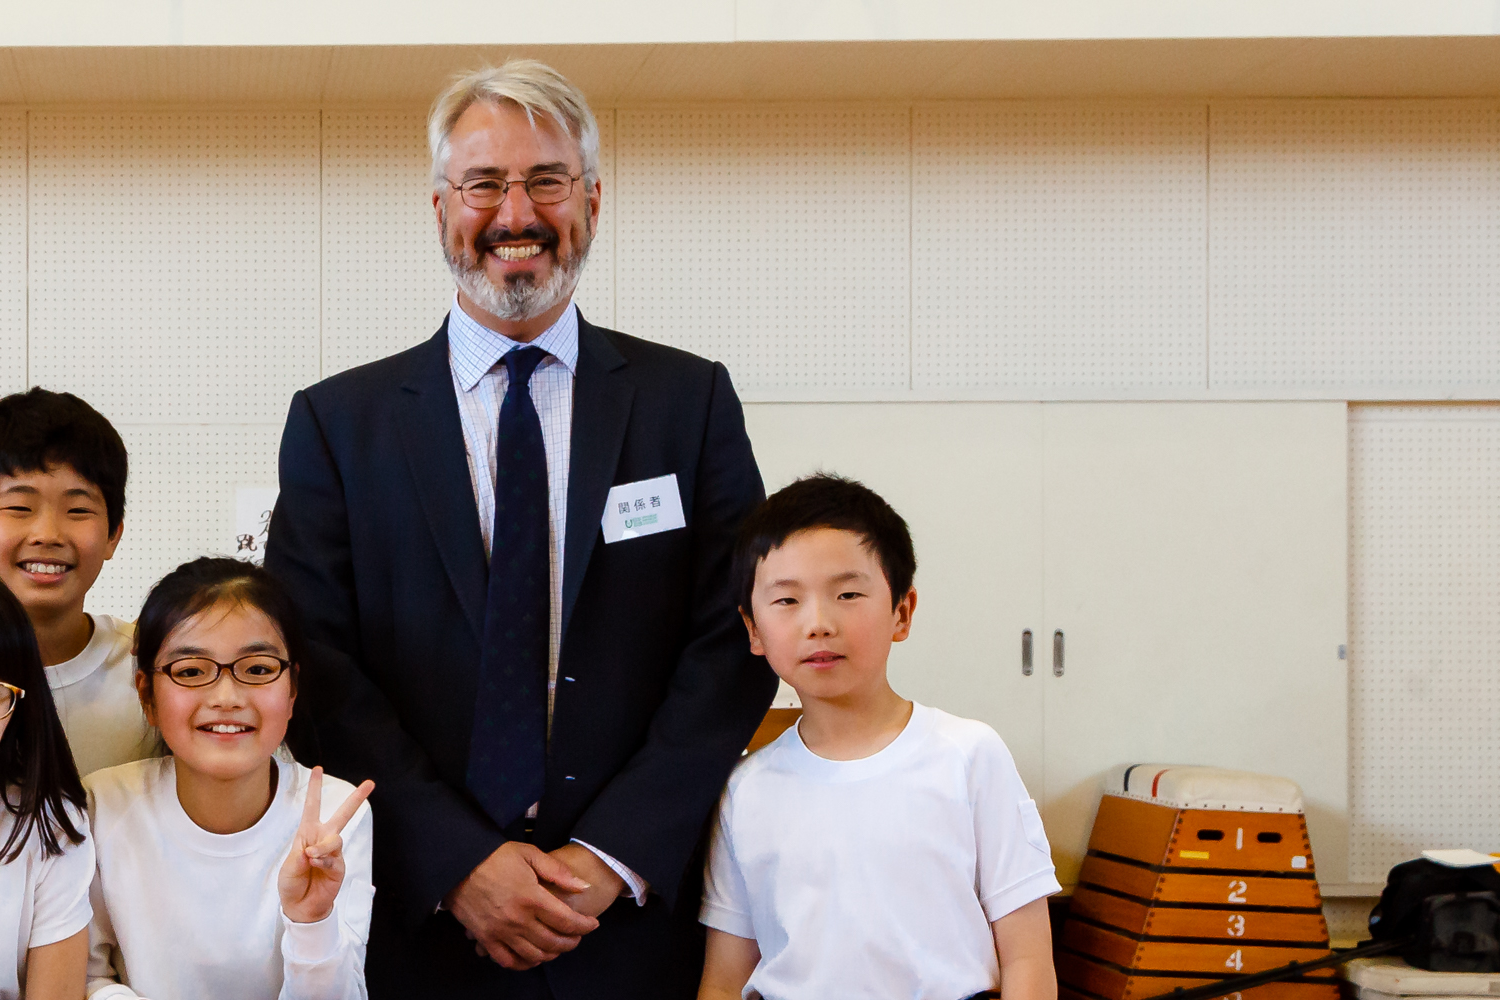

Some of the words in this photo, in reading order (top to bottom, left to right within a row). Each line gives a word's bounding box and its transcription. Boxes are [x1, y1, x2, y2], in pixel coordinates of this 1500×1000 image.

[618, 495, 661, 514] 関係者
[1236, 827, 1243, 850] 1
[1228, 880, 1247, 903] 2
[1227, 914, 1245, 937] 3
[1225, 949, 1243, 971] 4
